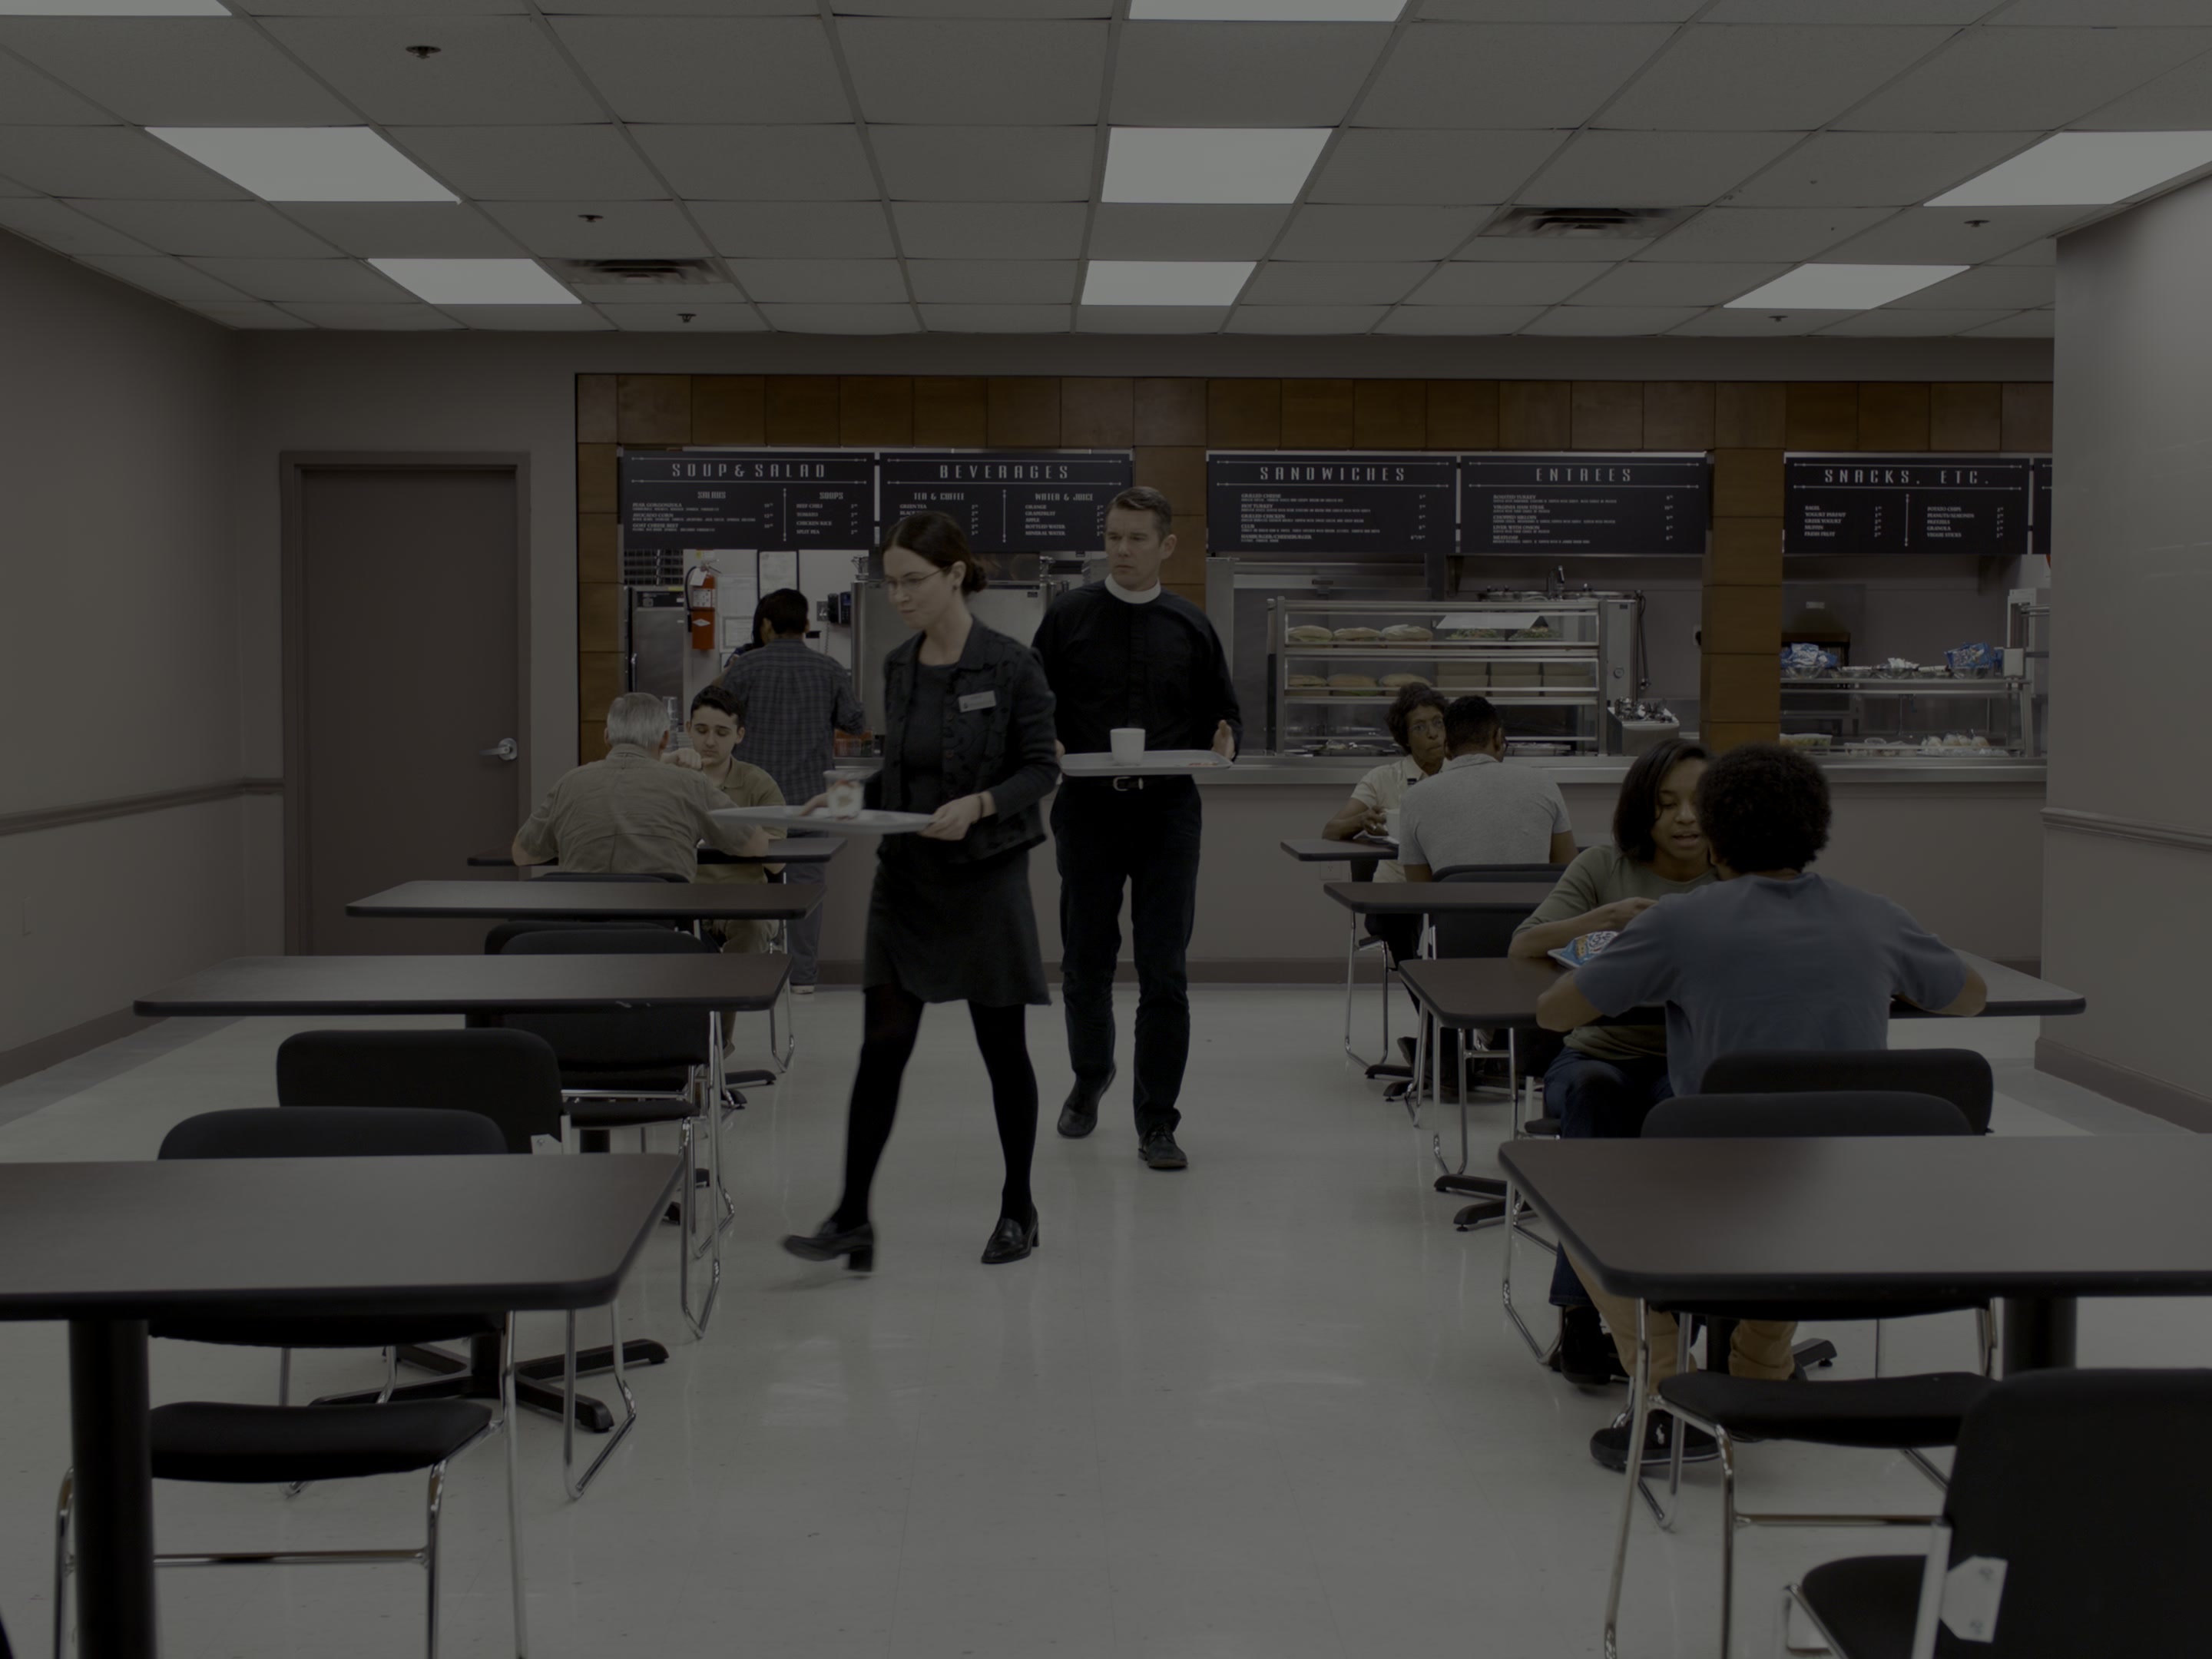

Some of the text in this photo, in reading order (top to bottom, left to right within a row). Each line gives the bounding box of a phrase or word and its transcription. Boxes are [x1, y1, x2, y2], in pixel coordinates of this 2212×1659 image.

[672, 463, 825, 477] SOUP & SALAD
[939, 465, 1068, 478] BEVERAGES
[1260, 466, 1405, 481] SANDWICHES
[1536, 468, 1631, 482] ENTREES
[1940, 469, 1989, 485] ETC.
[697, 491, 727, 499] SALADS
[819, 492, 844, 500] SOUPS
[914, 492, 965, 501] TEA & COFFEE
[1035, 493, 1094, 502] WATER & JUICE
